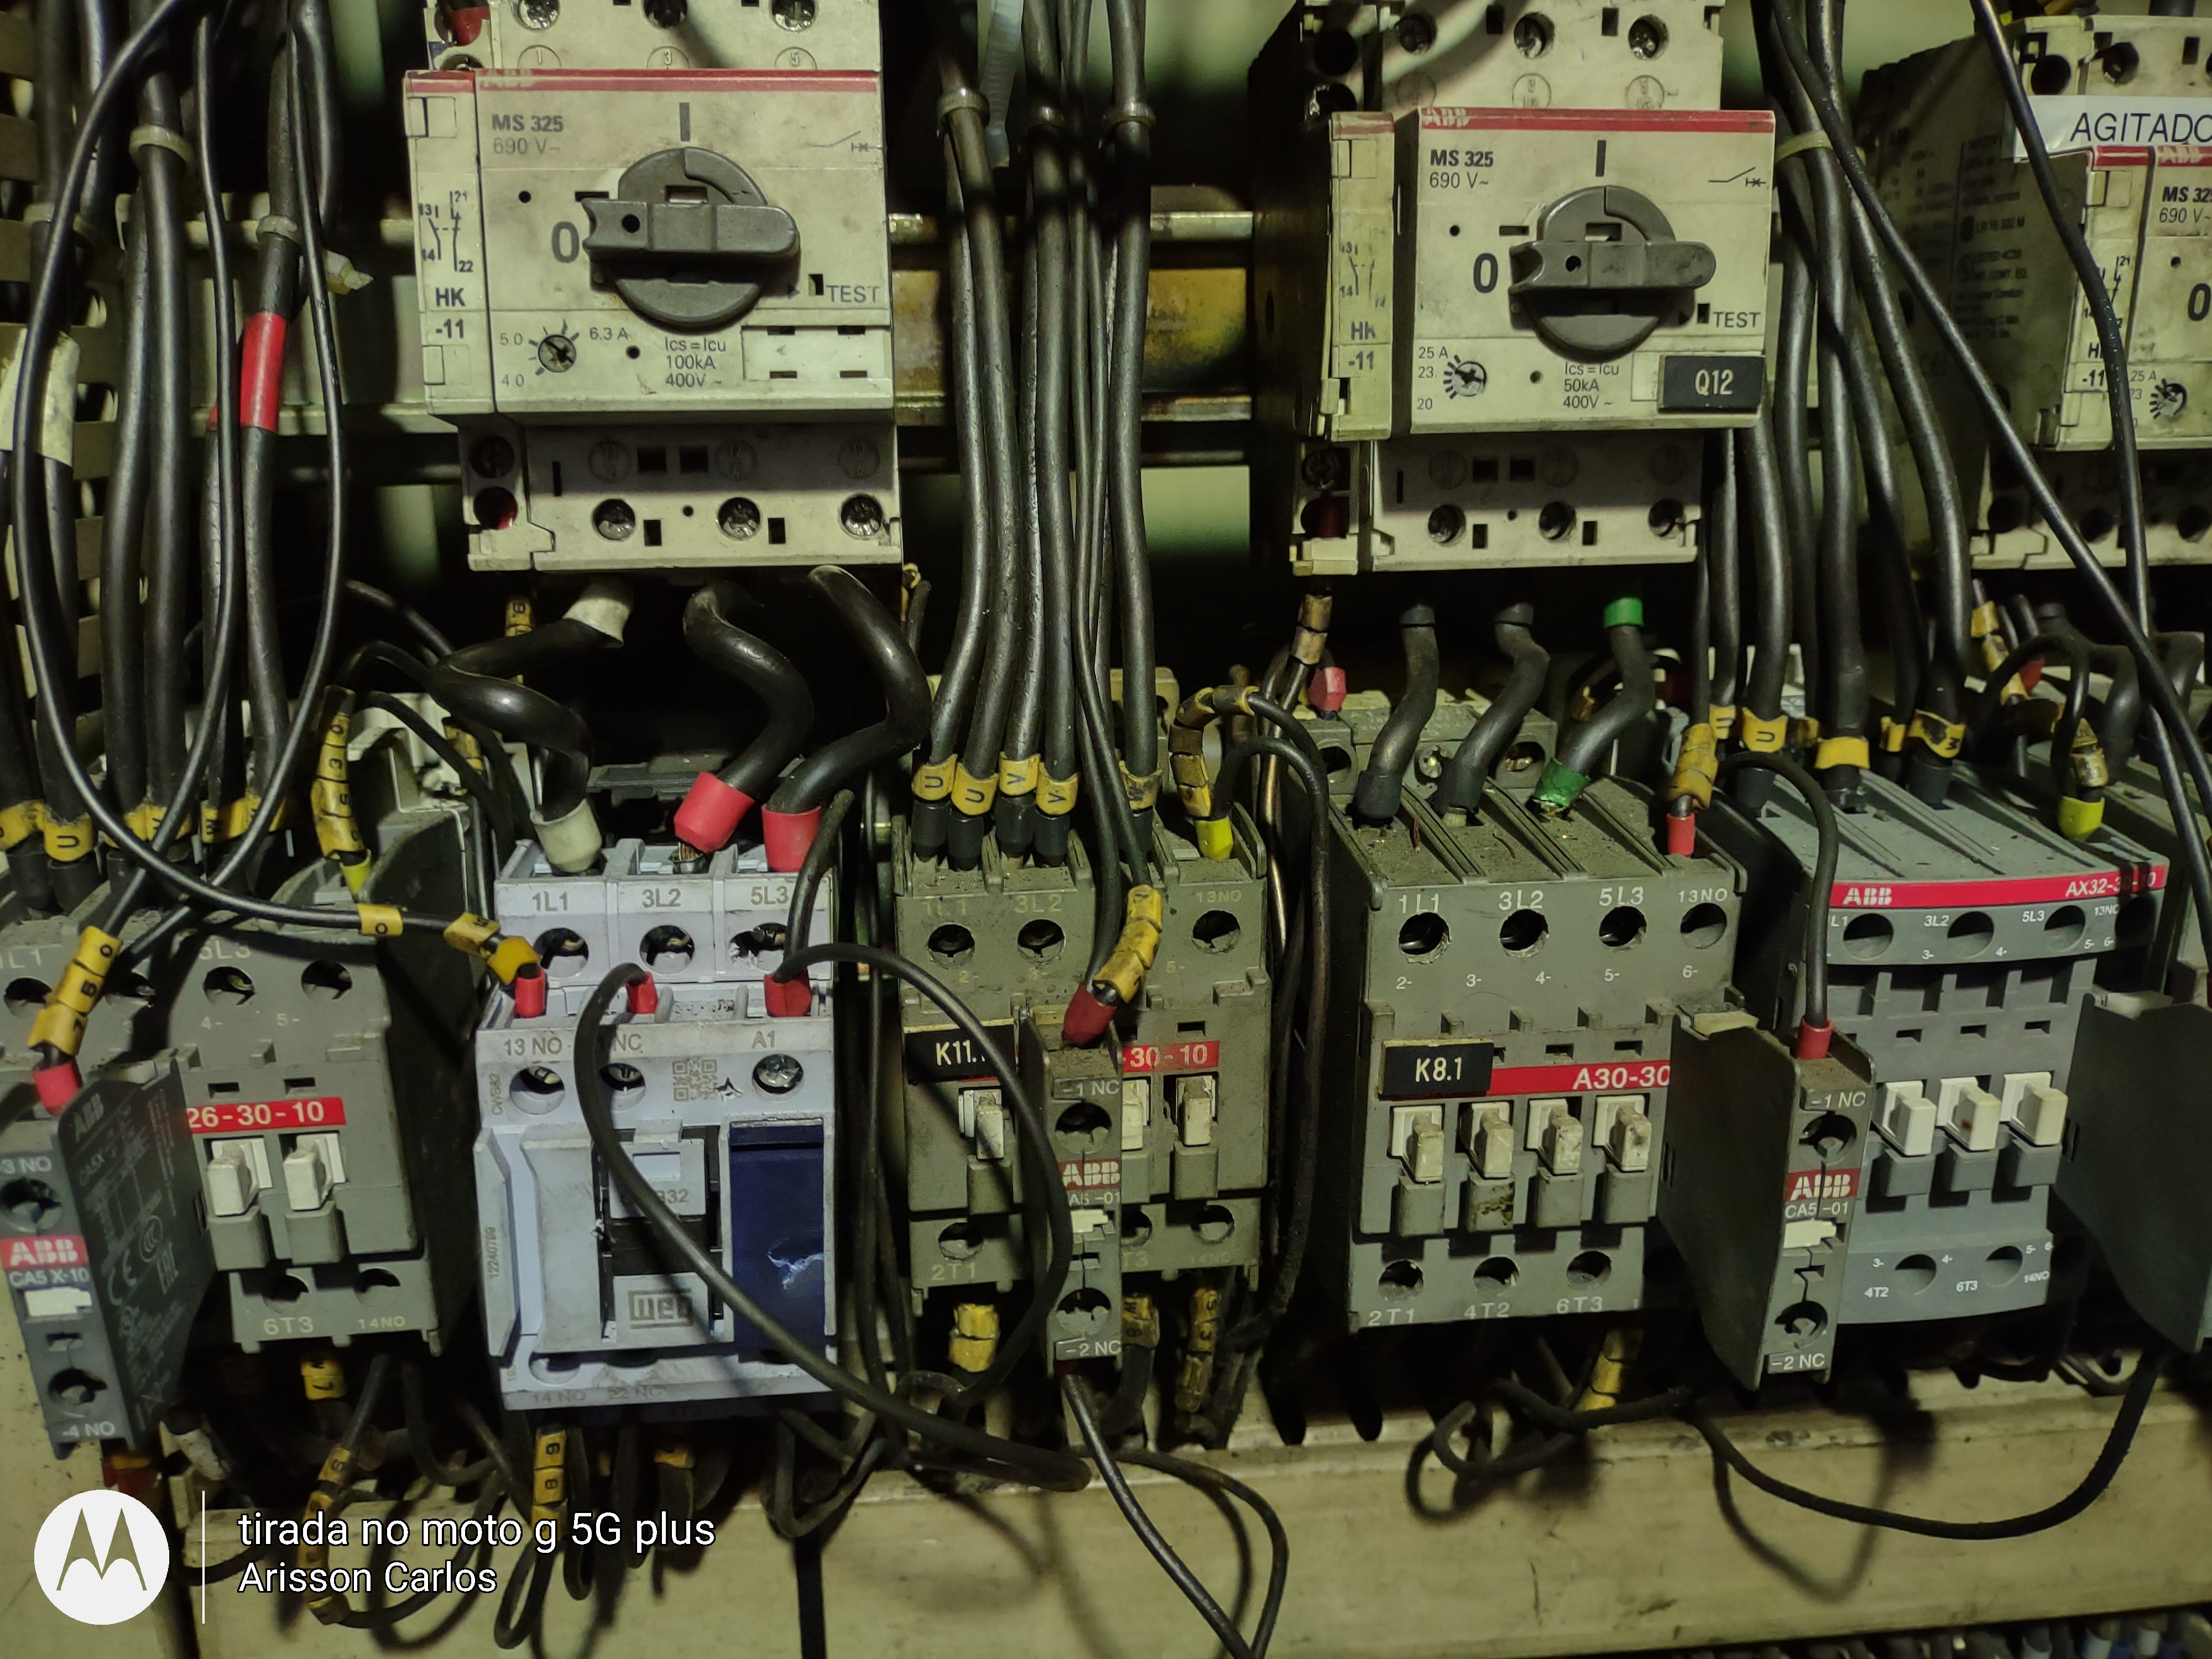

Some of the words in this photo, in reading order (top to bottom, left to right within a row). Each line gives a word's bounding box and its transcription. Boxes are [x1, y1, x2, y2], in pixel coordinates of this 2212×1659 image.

[492, 114, 525, 132] MS
[530, 115, 564, 133] 325
[493, 138, 528, 155] 690
[1430, 150, 1459, 167] MS
[1464, 150, 1494, 167] 325
[1430, 172, 1460, 188] 690
[2162, 186, 2189, 203] MS
[2159, 207, 2188, 224] 690
[551, 221, 580, 264] 0
[458, 260, 474, 273] 22
[1473, 253, 1499, 294] 0
[435, 287, 467, 307] HK
[826, 284, 881, 303] TEST
[2188, 282, 2211, 322] 0
[1713, 311, 1762, 328] TEST
[435, 318, 465, 339] -11
[589, 327, 613, 341] 6.3
[1348, 350, 1374, 371] -11
[1418, 346, 1434, 359] 25
[1439, 346, 1449, 359] A
[666, 355, 716, 370] 100kA
[665, 373, 707, 388] 400V
[1564, 378, 1600, 392] 50kA
[1694, 369, 1734, 396] Q12
[1417, 398, 1433, 410] 20
[1563, 395, 1599, 409] 400V
[1755, 731, 1775, 742] U
[924, 775, 943, 789] U
[1006, 773, 1026, 785] V
[964, 788, 985, 804] U
[1047, 792, 1067, 805] V
[56, 836, 80, 849] U
[531, 893, 568, 912] 1L1
[641, 888, 681, 908] 3L2
[750, 886, 789, 905] 5L3
[1014, 894, 1063, 914] 3L2
[1195, 888, 1242, 904] 13NO
[1398, 894, 1440, 914] 1L1
[1499, 890, 1543, 911] 3L2
[1598, 886, 1644, 907] 5L3
[1678, 888, 1728, 904] 13NO
[1842, 887, 1892, 906] ABB
[1830, 915, 1848, 927] L1
[1923, 914, 1949, 927] 3L2
[2022, 910, 2045, 923] 5L3
[503, 1038, 526, 1057] 13
[531, 1036, 562, 1056] NO
[752, 1031, 776, 1048] A1
[936, 1041, 985, 1066] K11.
[1416, 1057, 1462, 1082] K8.1
[1572, 1065, 1670, 1090] A30-30
[1091, 1080, 1120, 1096] NC
[1838, 1091, 1866, 1109] NC
[17, 1156, 52, 1175] NO
[1063, 1161, 1121, 1187] ABB
[1790, 1175, 1851, 1201] ABB
[1068, 1193, 1090, 1207] A5
[1785, 1203, 1818, 1218] CA5
[10, 1239, 79, 1266] ABB
[1121, 1250, 1149, 1269] T3
[1955, 1280, 1979, 1292] 6T3
[2023, 1271, 2050, 1284] 14NO
[1864, 1286, 1888, 1298] 4T2
[1464, 1302, 1510, 1319] 4T2
[1557, 1297, 1603, 1314] 6T3
[1368, 1308, 1415, 1326] 2T1
[263, 1316, 314, 1336] 6T3
[1095, 1340, 1121, 1357] NC
[1798, 1353, 1825, 1370] NC
[84, 1421, 116, 1436] NO
